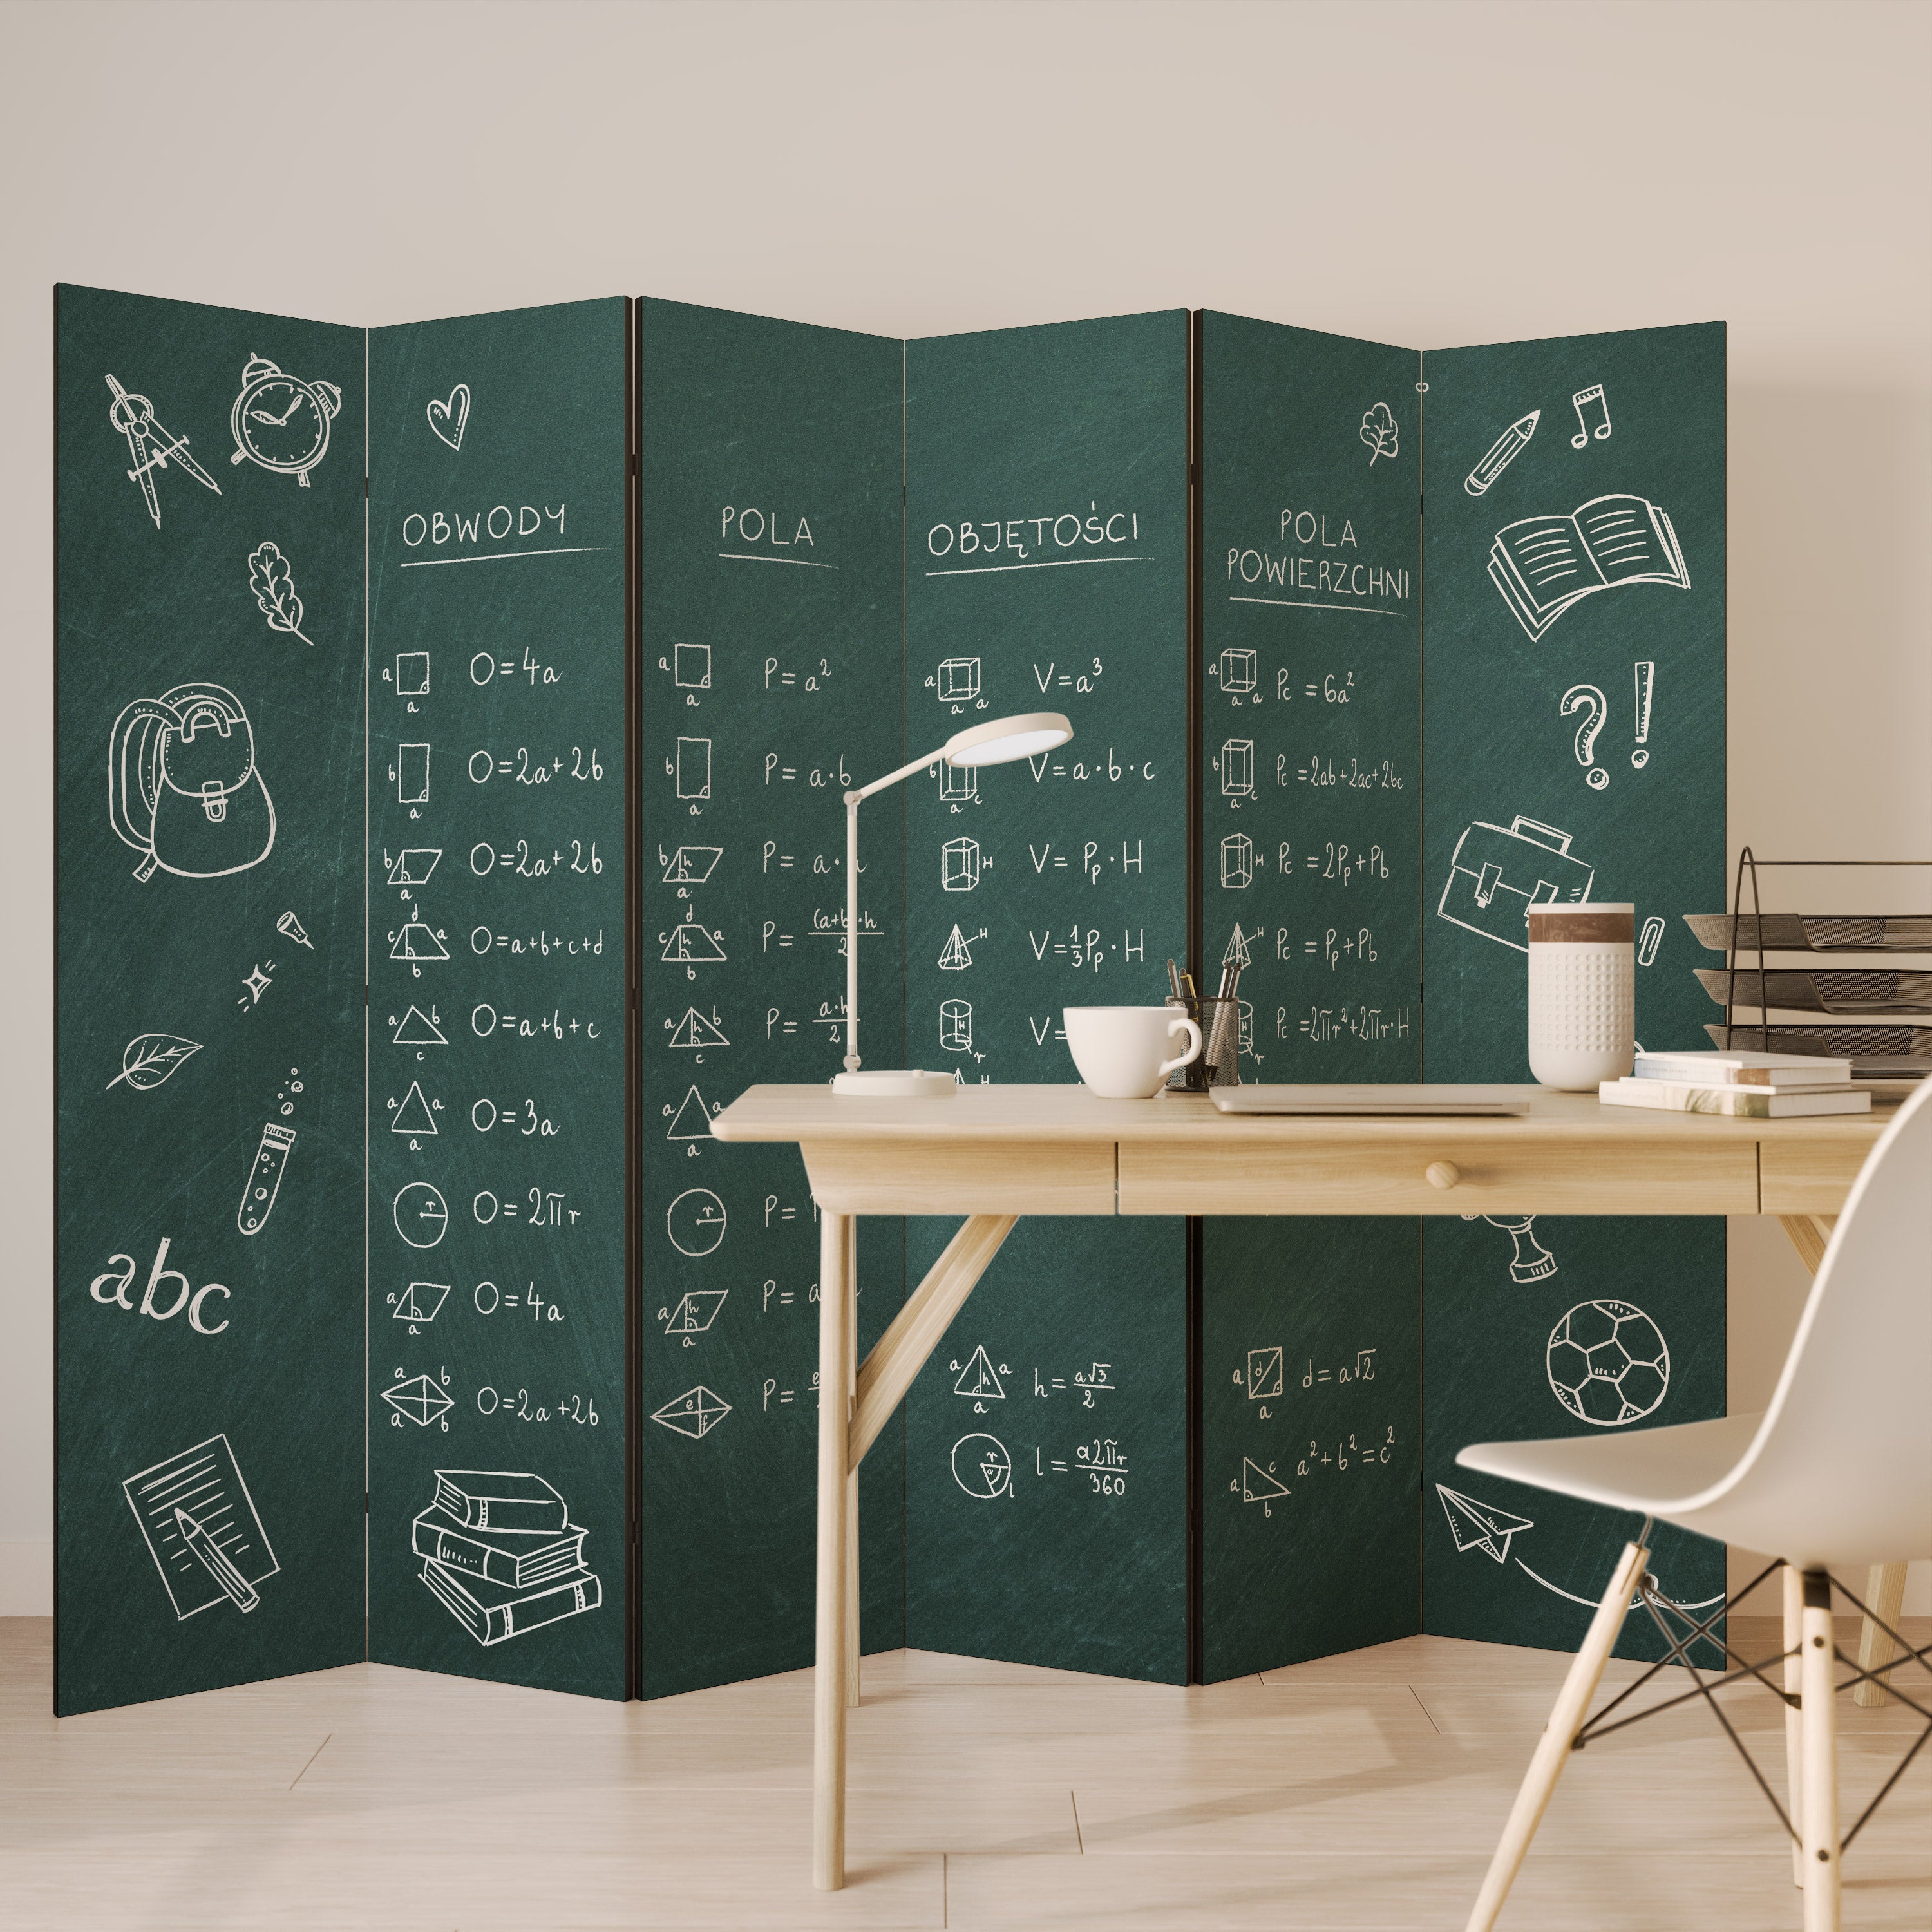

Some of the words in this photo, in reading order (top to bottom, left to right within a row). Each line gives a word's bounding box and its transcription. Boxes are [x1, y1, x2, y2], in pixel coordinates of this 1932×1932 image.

[402, 503, 565, 547] OBWODY
[721, 506, 814, 547] POLA
[927, 500, 1138, 558] OBJĘTOŚCI
[1280, 509, 1358, 549] POLA
[1227, 547, 1408, 600] POWIERZCHNI
[658, 656, 671, 672] a
[1208, 663, 1219, 676] a
[382, 668, 393, 682] a
[924, 675, 937, 687] a
[686, 694, 701, 706] a
[976, 698, 989, 710] a
[1231, 696, 1243, 706] a
[1252, 692, 1264, 705] a
[406, 701, 421, 713] a
[951, 704, 965, 715] a
[665, 757, 674, 775] b
[1213, 755, 1220, 772] b
[388, 764, 396, 782] b
[974, 794, 983, 805] c
[1251, 790, 1258, 800] c
[689, 804, 703, 816] a
[950, 803, 963, 814] a
[1231, 798, 1242, 809] a
[410, 808, 422, 820] a
[384, 847, 392, 869] b
[659, 844, 668, 866] b
[683, 855, 693, 867] h
[1255, 853, 1264, 867] H
[983, 856, 994, 869] H
[400, 889, 414, 900] a
[677, 887, 691, 899] a
[411, 903, 419, 922] d
[685, 903, 694, 922] d
[387, 930, 395, 943] c
[436, 929, 448, 940] a
[658, 931, 668, 944] c
[713, 929, 725, 941] a
[980, 927, 988, 939] H
[1257, 925, 1264, 938] H
[683, 933, 692, 945] h
[412, 963, 421, 978] b
[687, 965, 696, 980] b
[388, 1014, 401, 1026] a
[431, 1004, 440, 1025] b
[712, 1005, 721, 1026] b
[664, 1018, 677, 1030] a
[693, 1020, 703, 1032] h
[958, 1019, 965, 1030] H
[1242, 1021, 1247, 1032] H
[417, 1051, 425, 1061] c
[696, 1054, 705, 1064] c
[973, 1052, 987, 1064] r
[1254, 1053, 1265, 1065] r
[386, 1097, 400, 1110] a
[431, 1098, 445, 1110] a
[661, 1103, 676, 1117] a
[712, 1101, 723, 1113] a
[409, 1138, 423, 1151] a
[687, 1144, 703, 1157] a
[424, 1200, 436, 1211] r
[702, 1206, 714, 1217] r
[90, 1236, 231, 1334] abc
[386, 1292, 399, 1305] a
[688, 1300, 699, 1314] h
[658, 1307, 670, 1321] a
[408, 1324, 422, 1336] a
[682, 1336, 697, 1348] a
[949, 1359, 963, 1372] a
[999, 1363, 1014, 1375] a
[1255, 1361, 1262, 1377] d
[394, 1367, 407, 1379] a
[440, 1365, 451, 1386] b
[982, 1372, 991, 1385] h
[1233, 1368, 1244, 1385] a
[685, 1399, 694, 1410] e
[973, 1401, 989, 1414] a
[1259, 1405, 1273, 1420] a
[390, 1412, 405, 1428] a
[440, 1414, 449, 1433] b
[985, 1452, 998, 1463] r
[1269, 1461, 1276, 1473] c
[1009, 1482, 1015, 1499] l
[1089, 1472, 1126, 1496] 360
[1230, 1479, 1241, 1492] a
[1265, 1501, 1272, 1519] b
